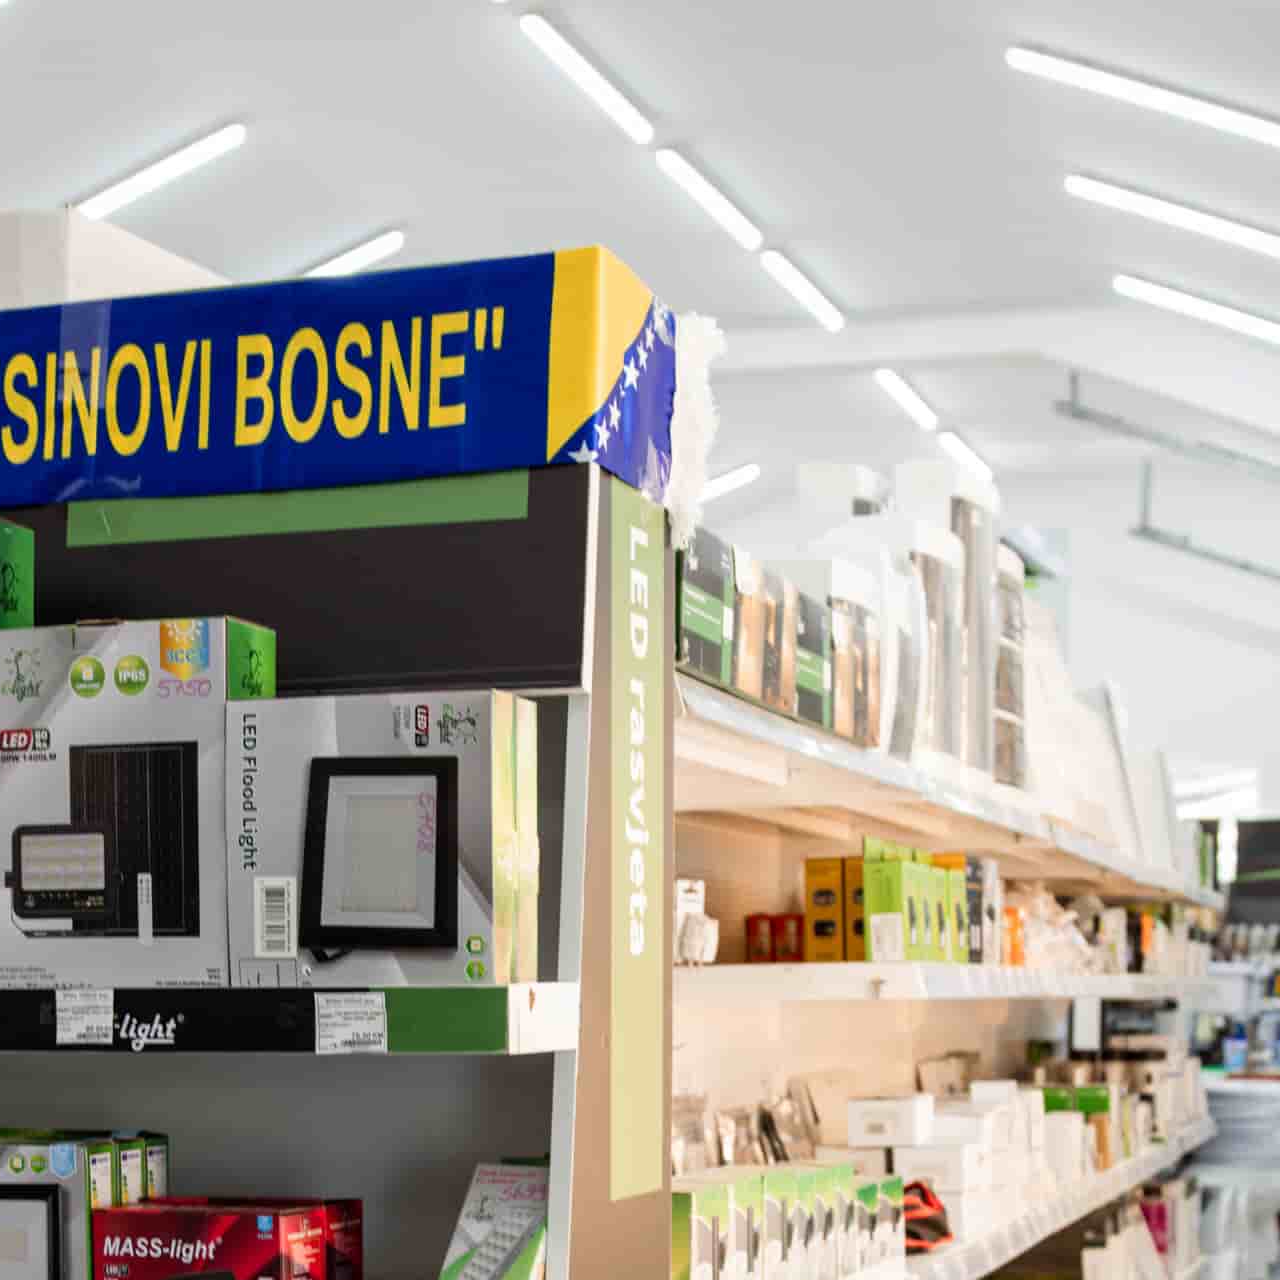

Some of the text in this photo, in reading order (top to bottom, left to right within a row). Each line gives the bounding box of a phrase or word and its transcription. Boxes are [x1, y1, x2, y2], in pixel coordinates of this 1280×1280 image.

[234, 307, 506, 447] BOSNE"
[118, 669, 146, 682] IP65
[2, 732, 28, 748] LED
[625, 527, 649, 956] LED rasvjeta
[238, 713, 259, 871] LED Flood Light
[103, 1236, 216, 1264] MASS-light
